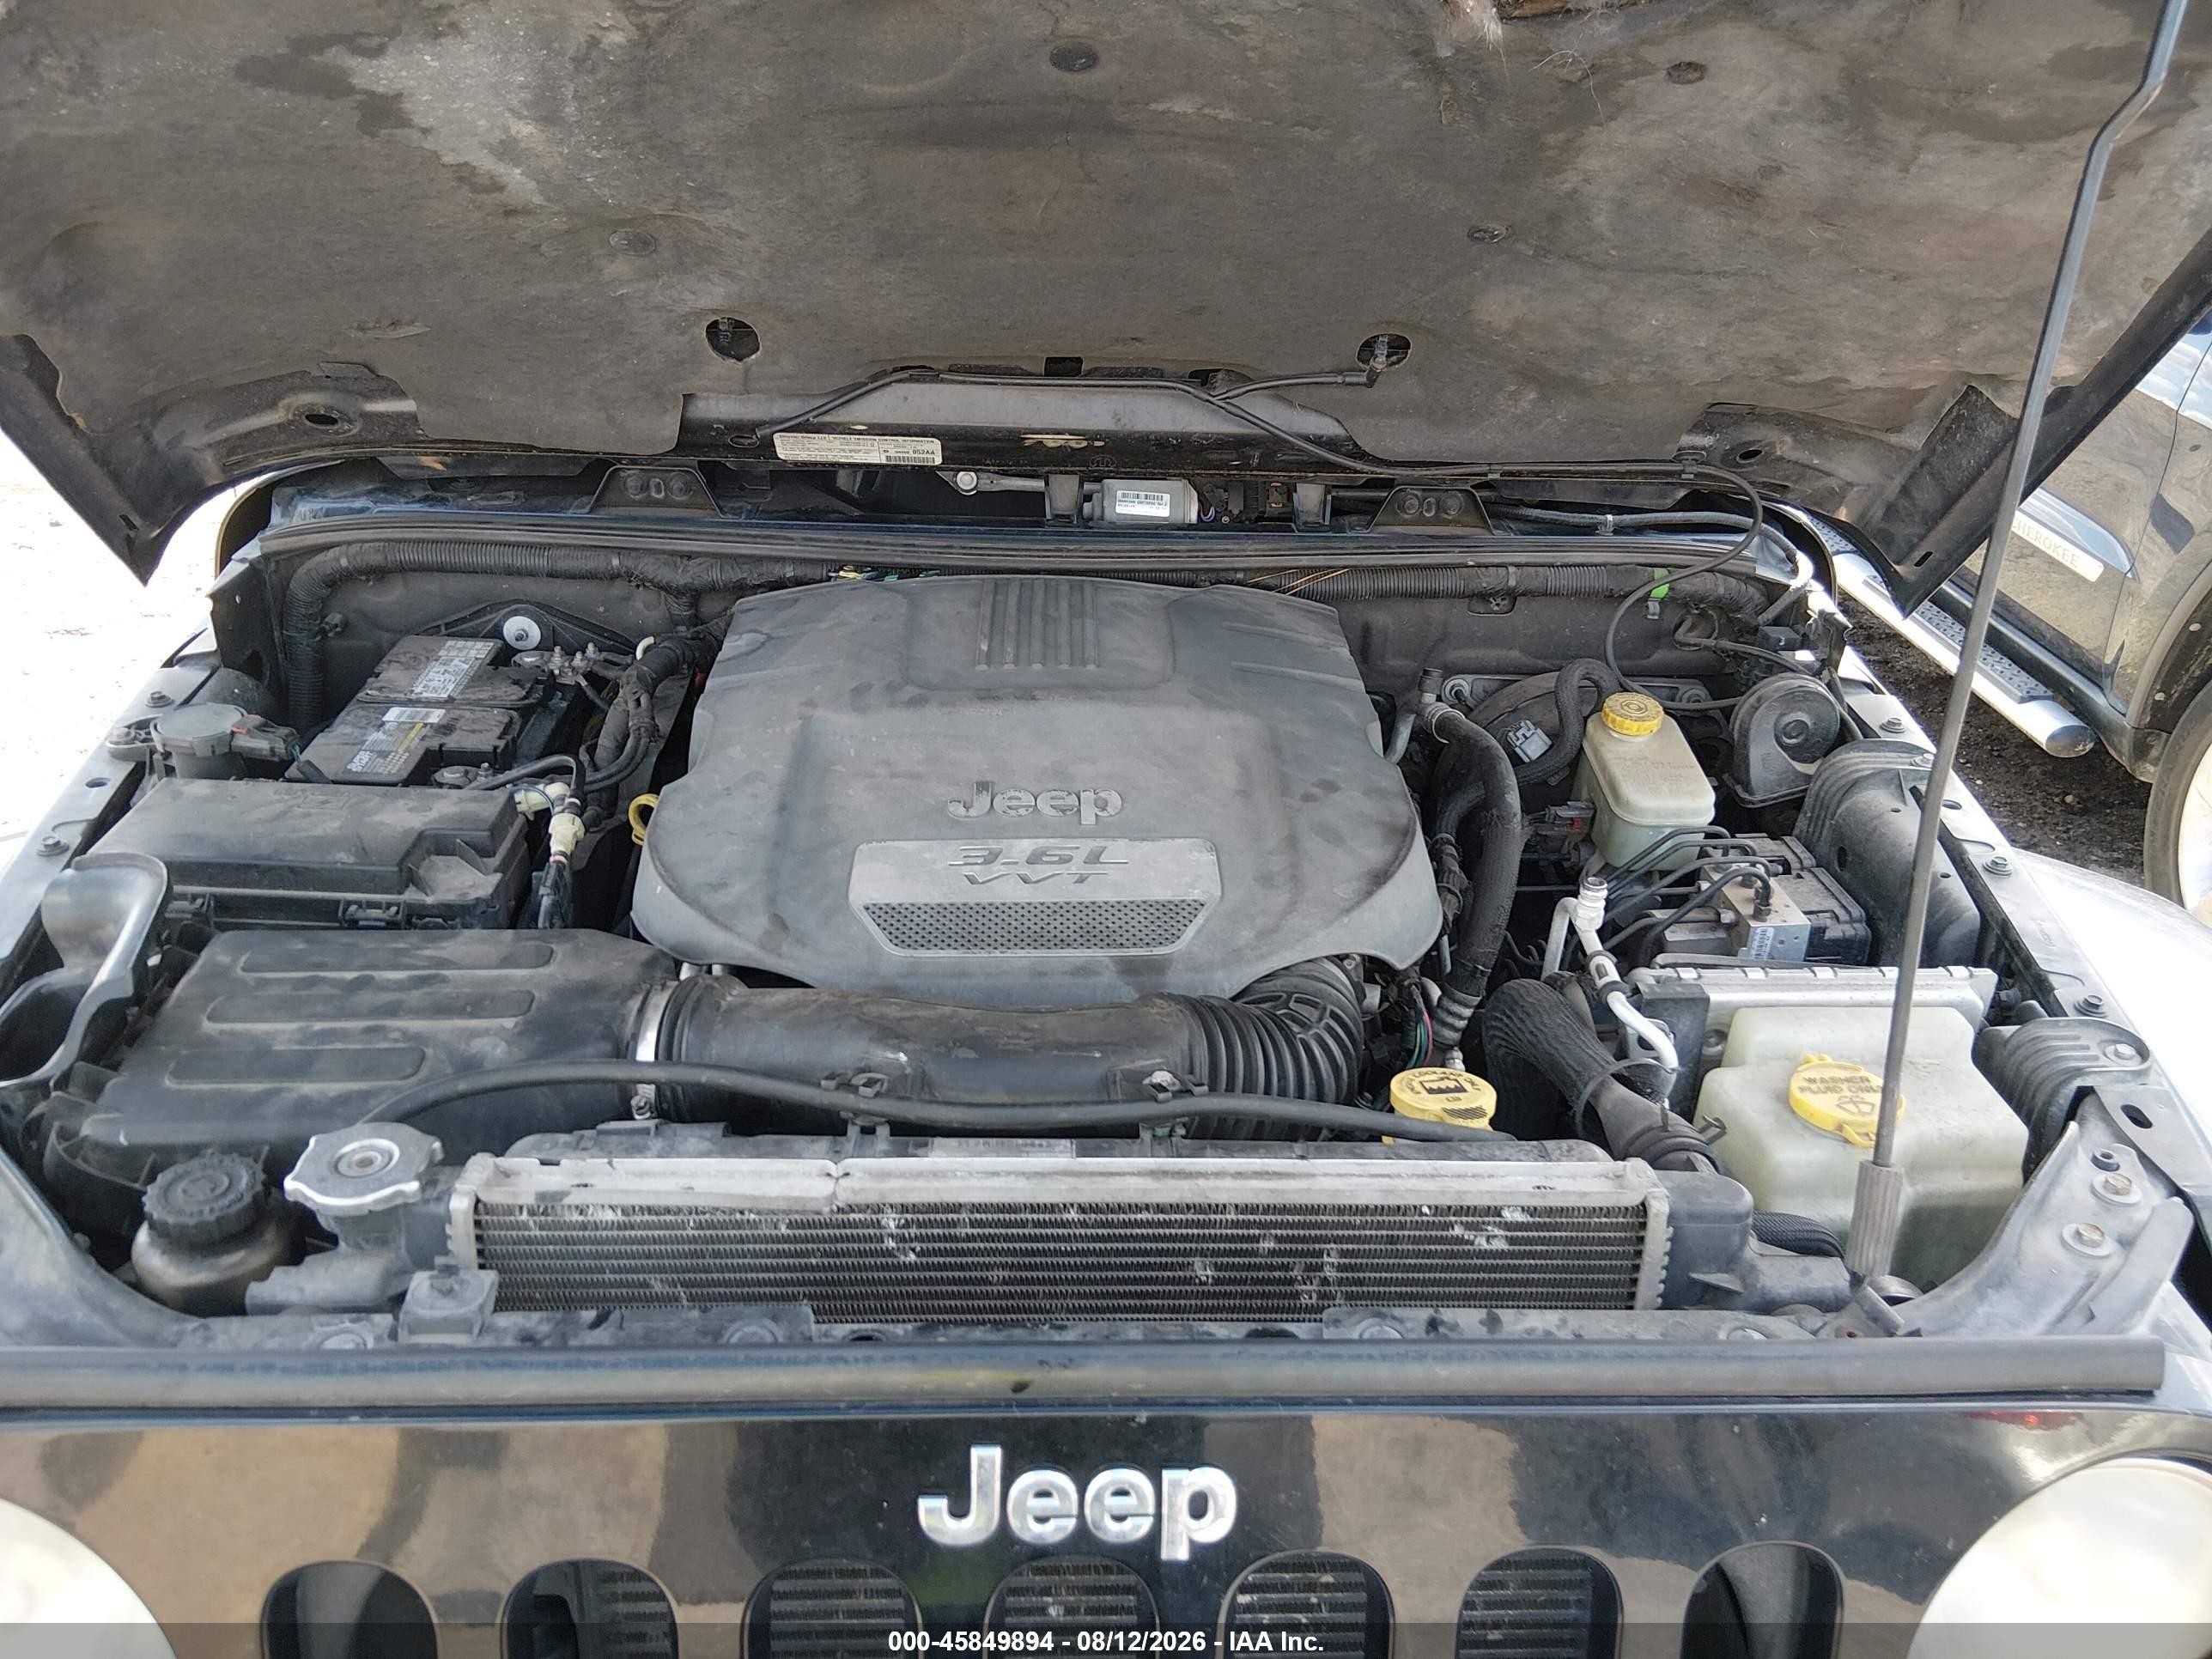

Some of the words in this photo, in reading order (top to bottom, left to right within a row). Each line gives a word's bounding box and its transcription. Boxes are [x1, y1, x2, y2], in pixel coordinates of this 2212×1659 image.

[947, 781, 1122, 825] Jeep
[948, 845, 1129, 867] 3.6L
[963, 872, 1109, 885] VVT
[1803, 1076, 1872, 1085] WASHER
[1798, 1085, 1843, 1094] FLUID
[917, 1444, 1237, 1561] Jeep
